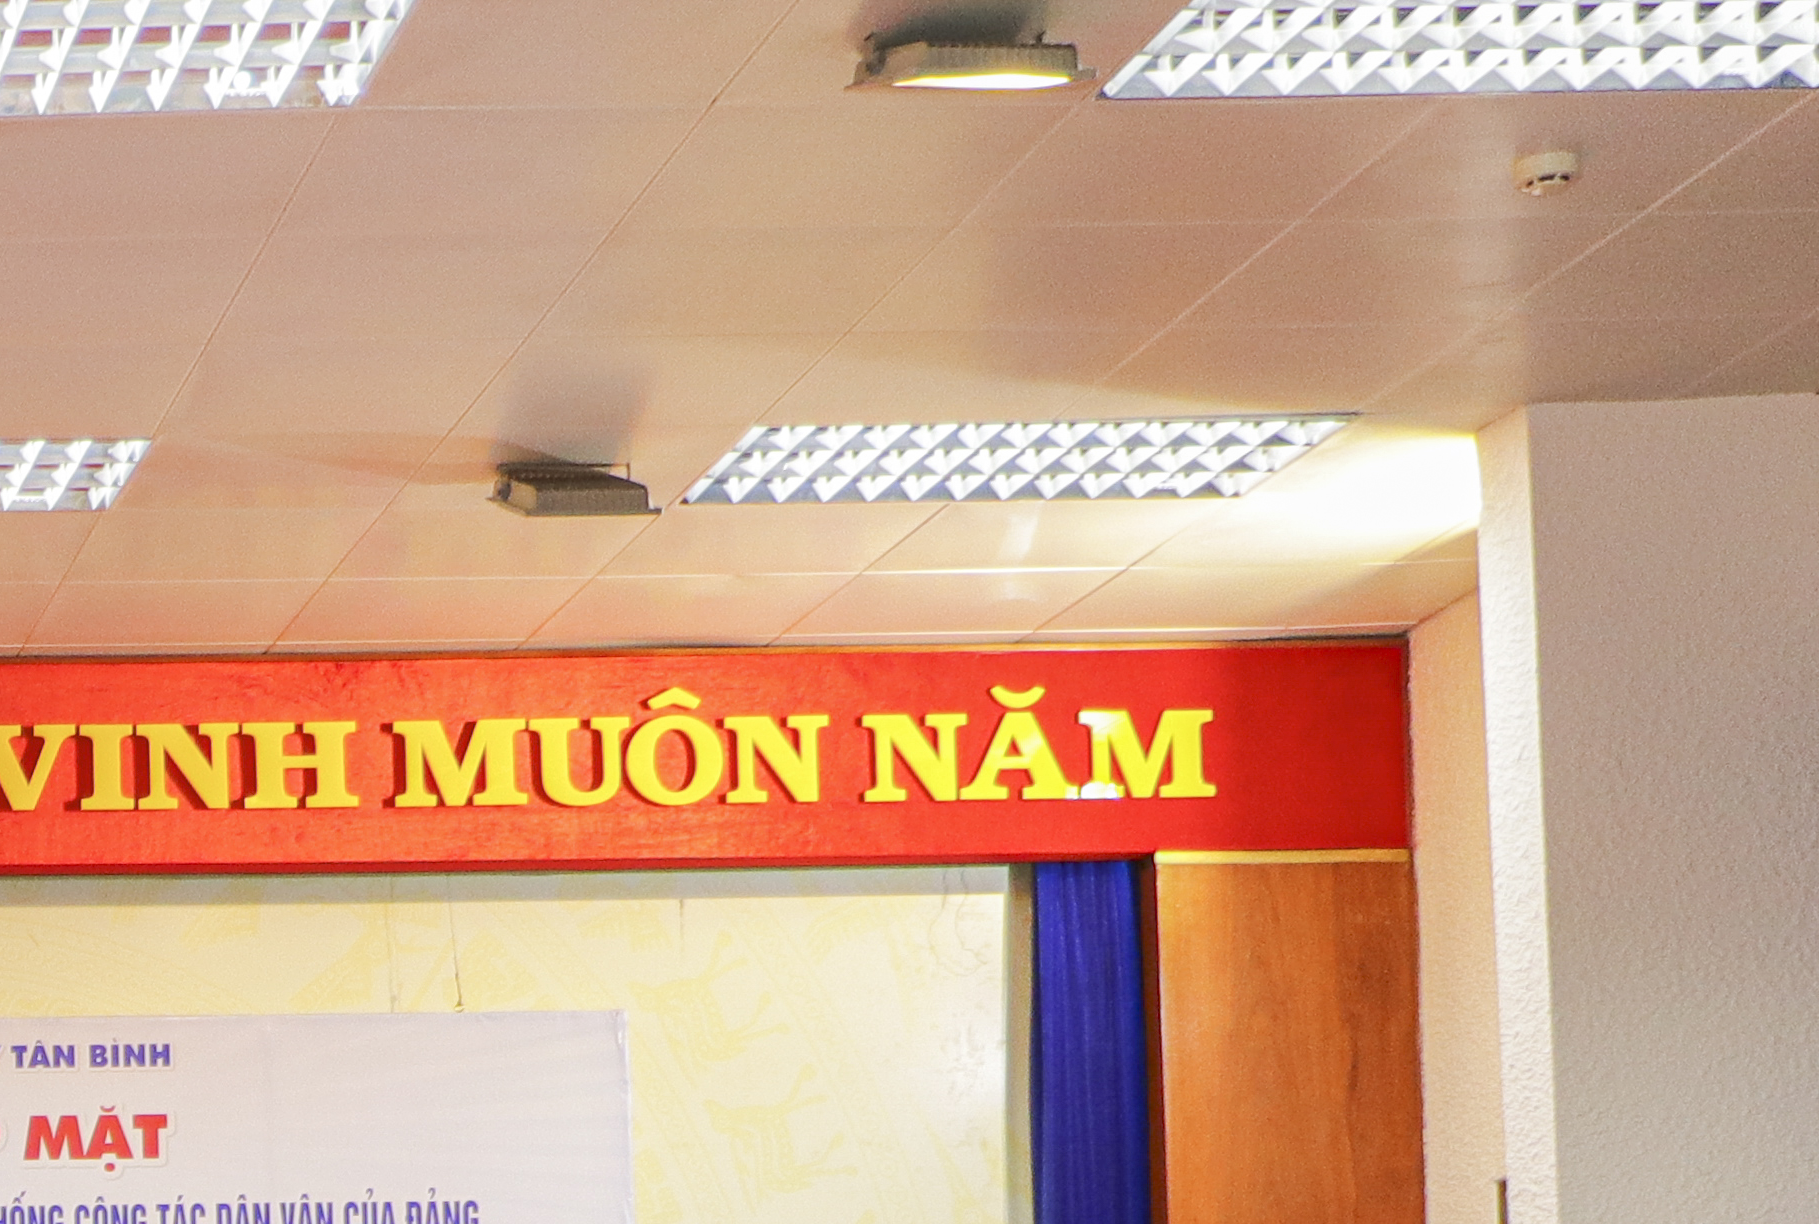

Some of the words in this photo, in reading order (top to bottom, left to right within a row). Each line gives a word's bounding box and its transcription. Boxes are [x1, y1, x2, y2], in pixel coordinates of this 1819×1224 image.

[391, 686, 830, 808] MUÔN
[862, 685, 1217, 802] NĂM
[10, 1039, 76, 1069] TÂN
[88, 1038, 171, 1068] BÌNH
[23, 1104, 169, 1173] MẶT
